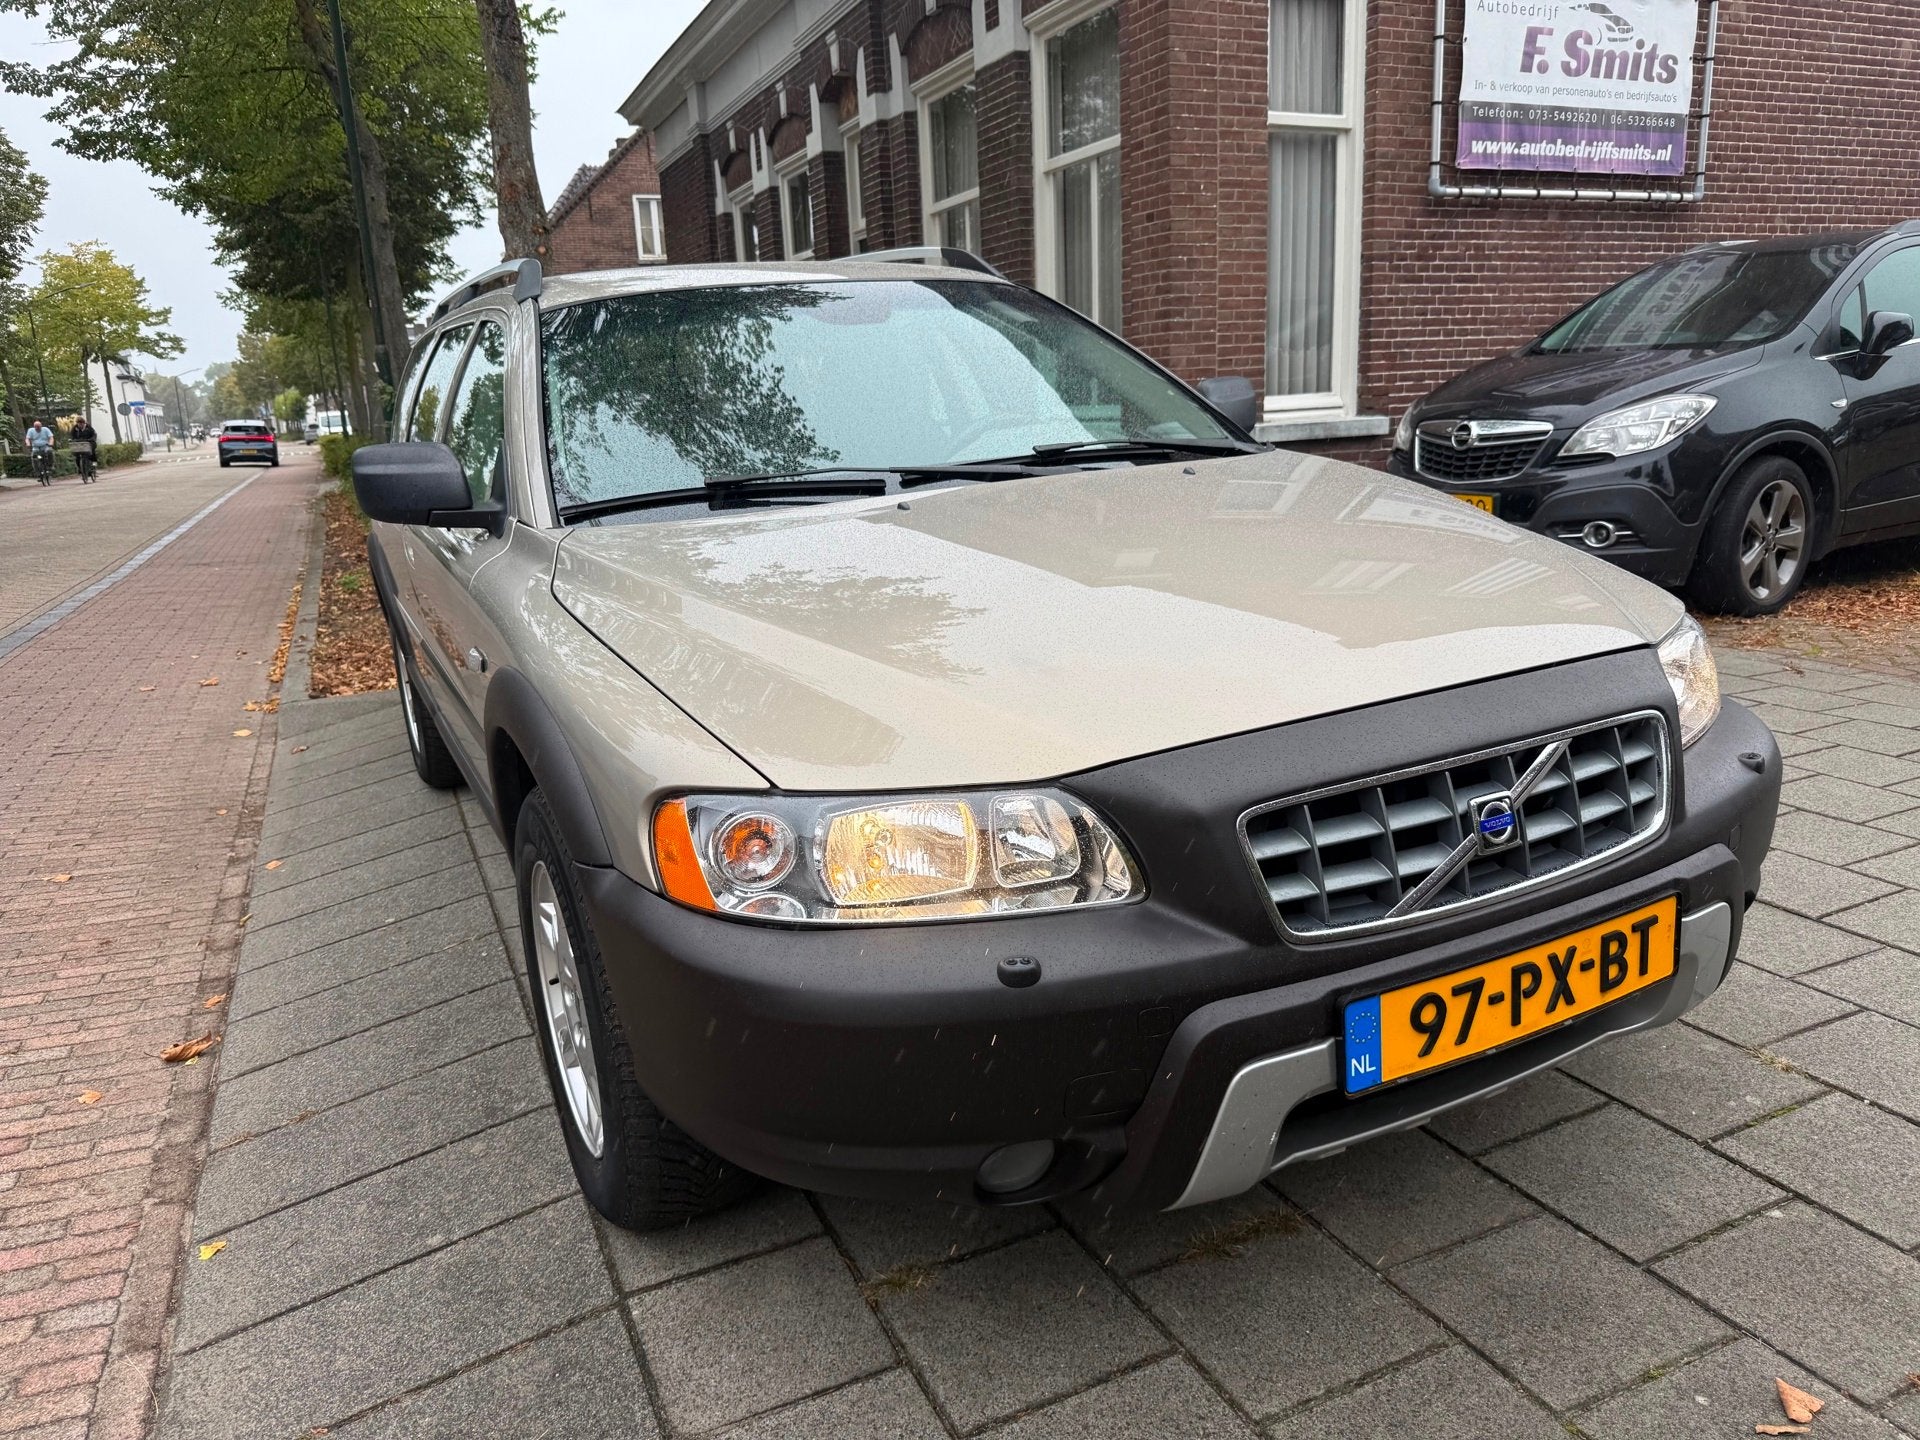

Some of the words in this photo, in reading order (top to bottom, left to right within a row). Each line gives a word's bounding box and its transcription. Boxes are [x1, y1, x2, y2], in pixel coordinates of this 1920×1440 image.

[1477, 0, 1559, 20] Autobedrijf
[1520, 26, 1553, 75] F.
[1560, 29, 1679, 84] Smits
[1474, 80, 1487, 90] In-
[1490, 81, 1496, 91] &
[1500, 82, 1533, 95] verkoop
[1536, 86, 1549, 95] van
[1552, 86, 1612, 99] personenauto's
[1614, 91, 1624, 100] en
[1626, 90, 1677, 103] bedrijfsauto's
[1472, 106, 1523, 119] Telefoon:
[1528, 109, 1598, 123] 073-5492620
[1611, 115, 1675, 128] 06-53266648
[1471, 138, 1672, 162] www.autobedrijffsmits.nl
[1483, 816, 1512, 829] VOLVO
[1410, 914, 1658, 1058] 97-PX-BT
[1351, 1053, 1377, 1077] NL
